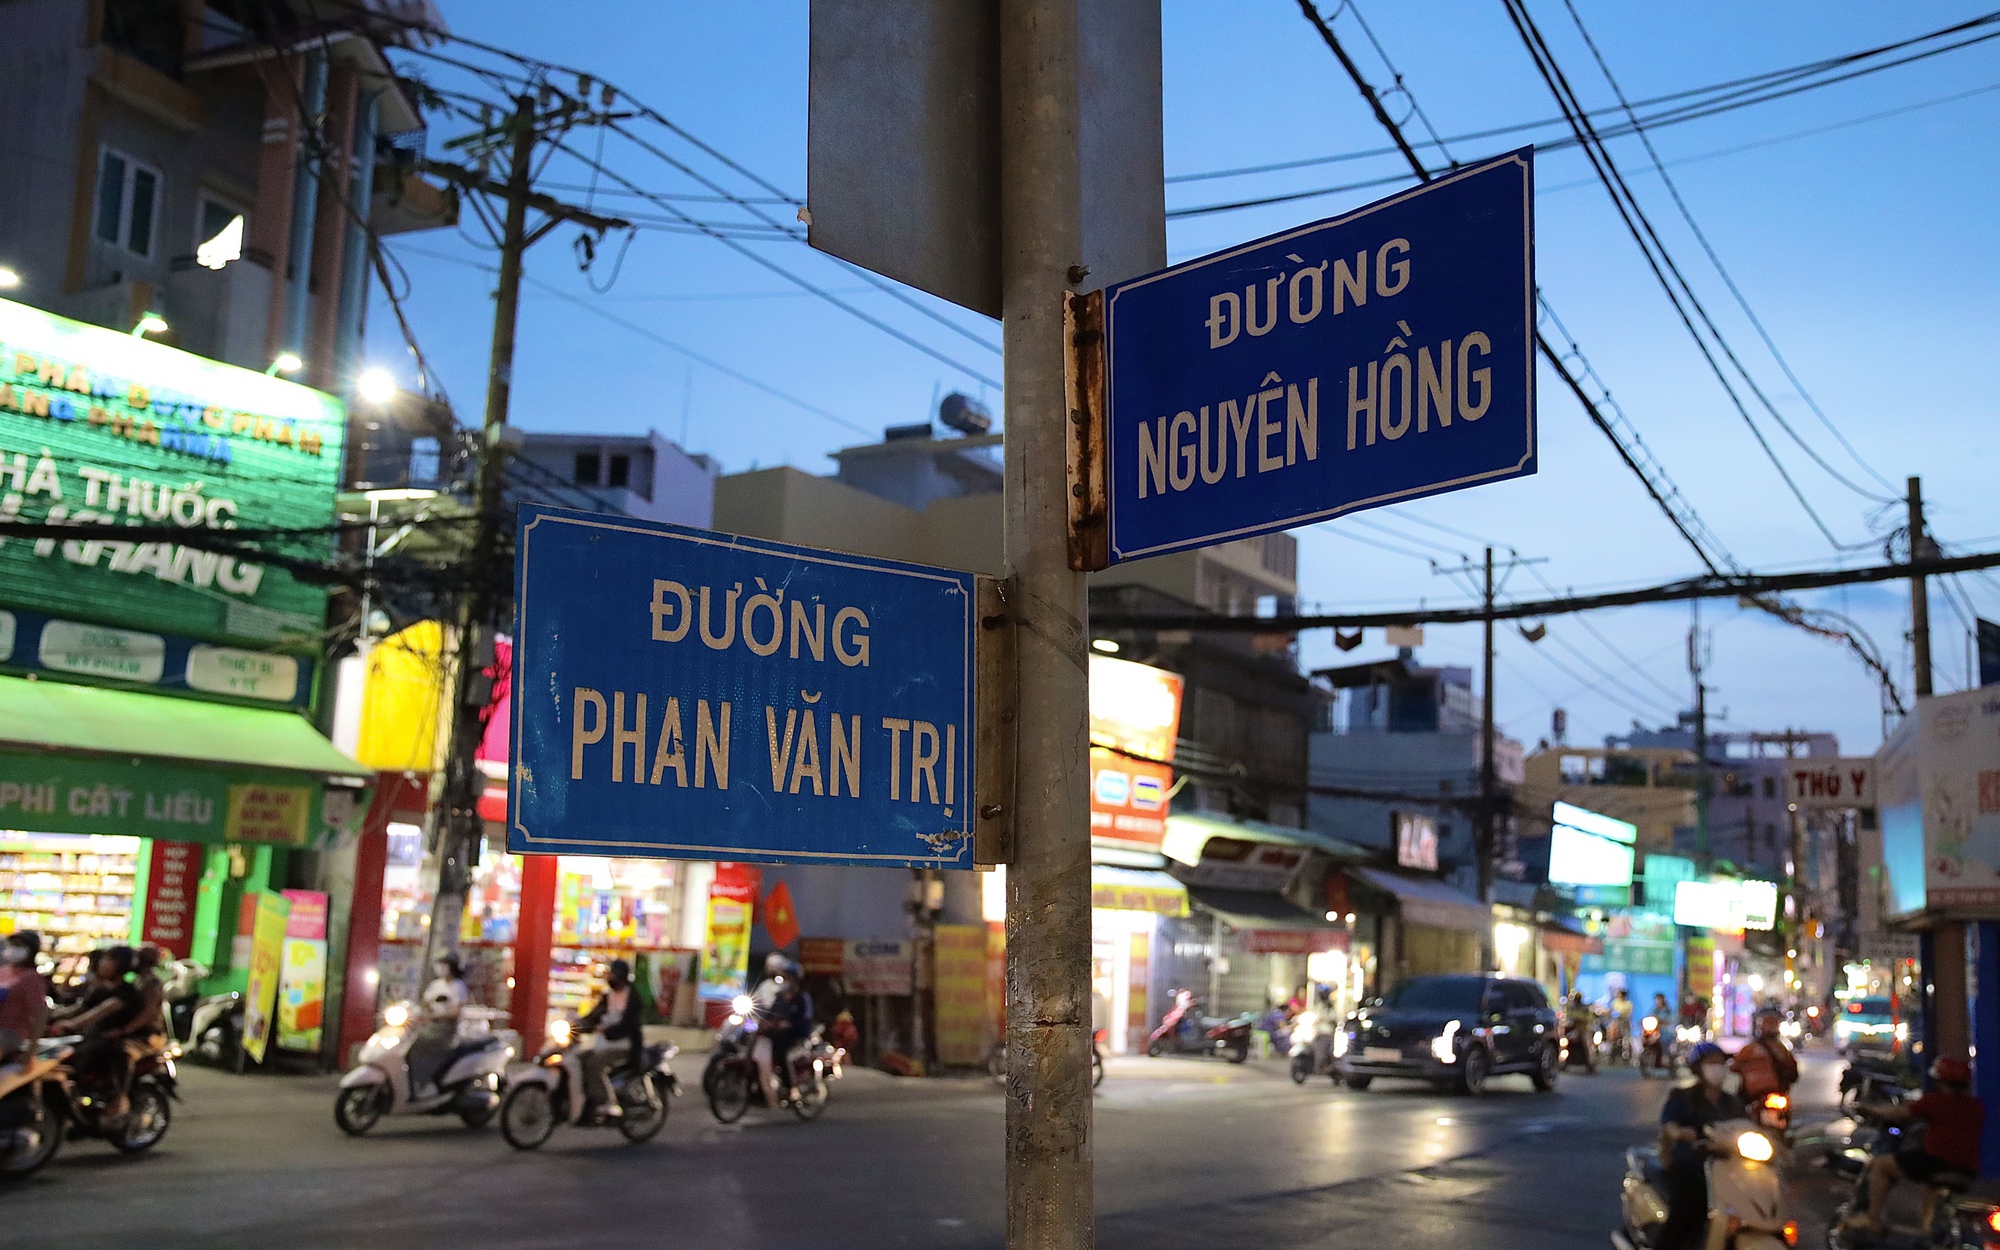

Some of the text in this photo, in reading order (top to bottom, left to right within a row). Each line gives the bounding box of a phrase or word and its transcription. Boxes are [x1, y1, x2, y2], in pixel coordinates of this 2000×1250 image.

[1204, 237, 1412, 350] ĐƯỜNG
[1137, 319, 1493, 500] NGUYÊN HỒNG
[78, 465, 239, 530] THUỐC
[649, 576, 871, 667] ĐƯỜNG
[570, 686, 957, 818] PHAN VĂN TRỊ
[1794, 766, 1866, 798] THÚ Y
